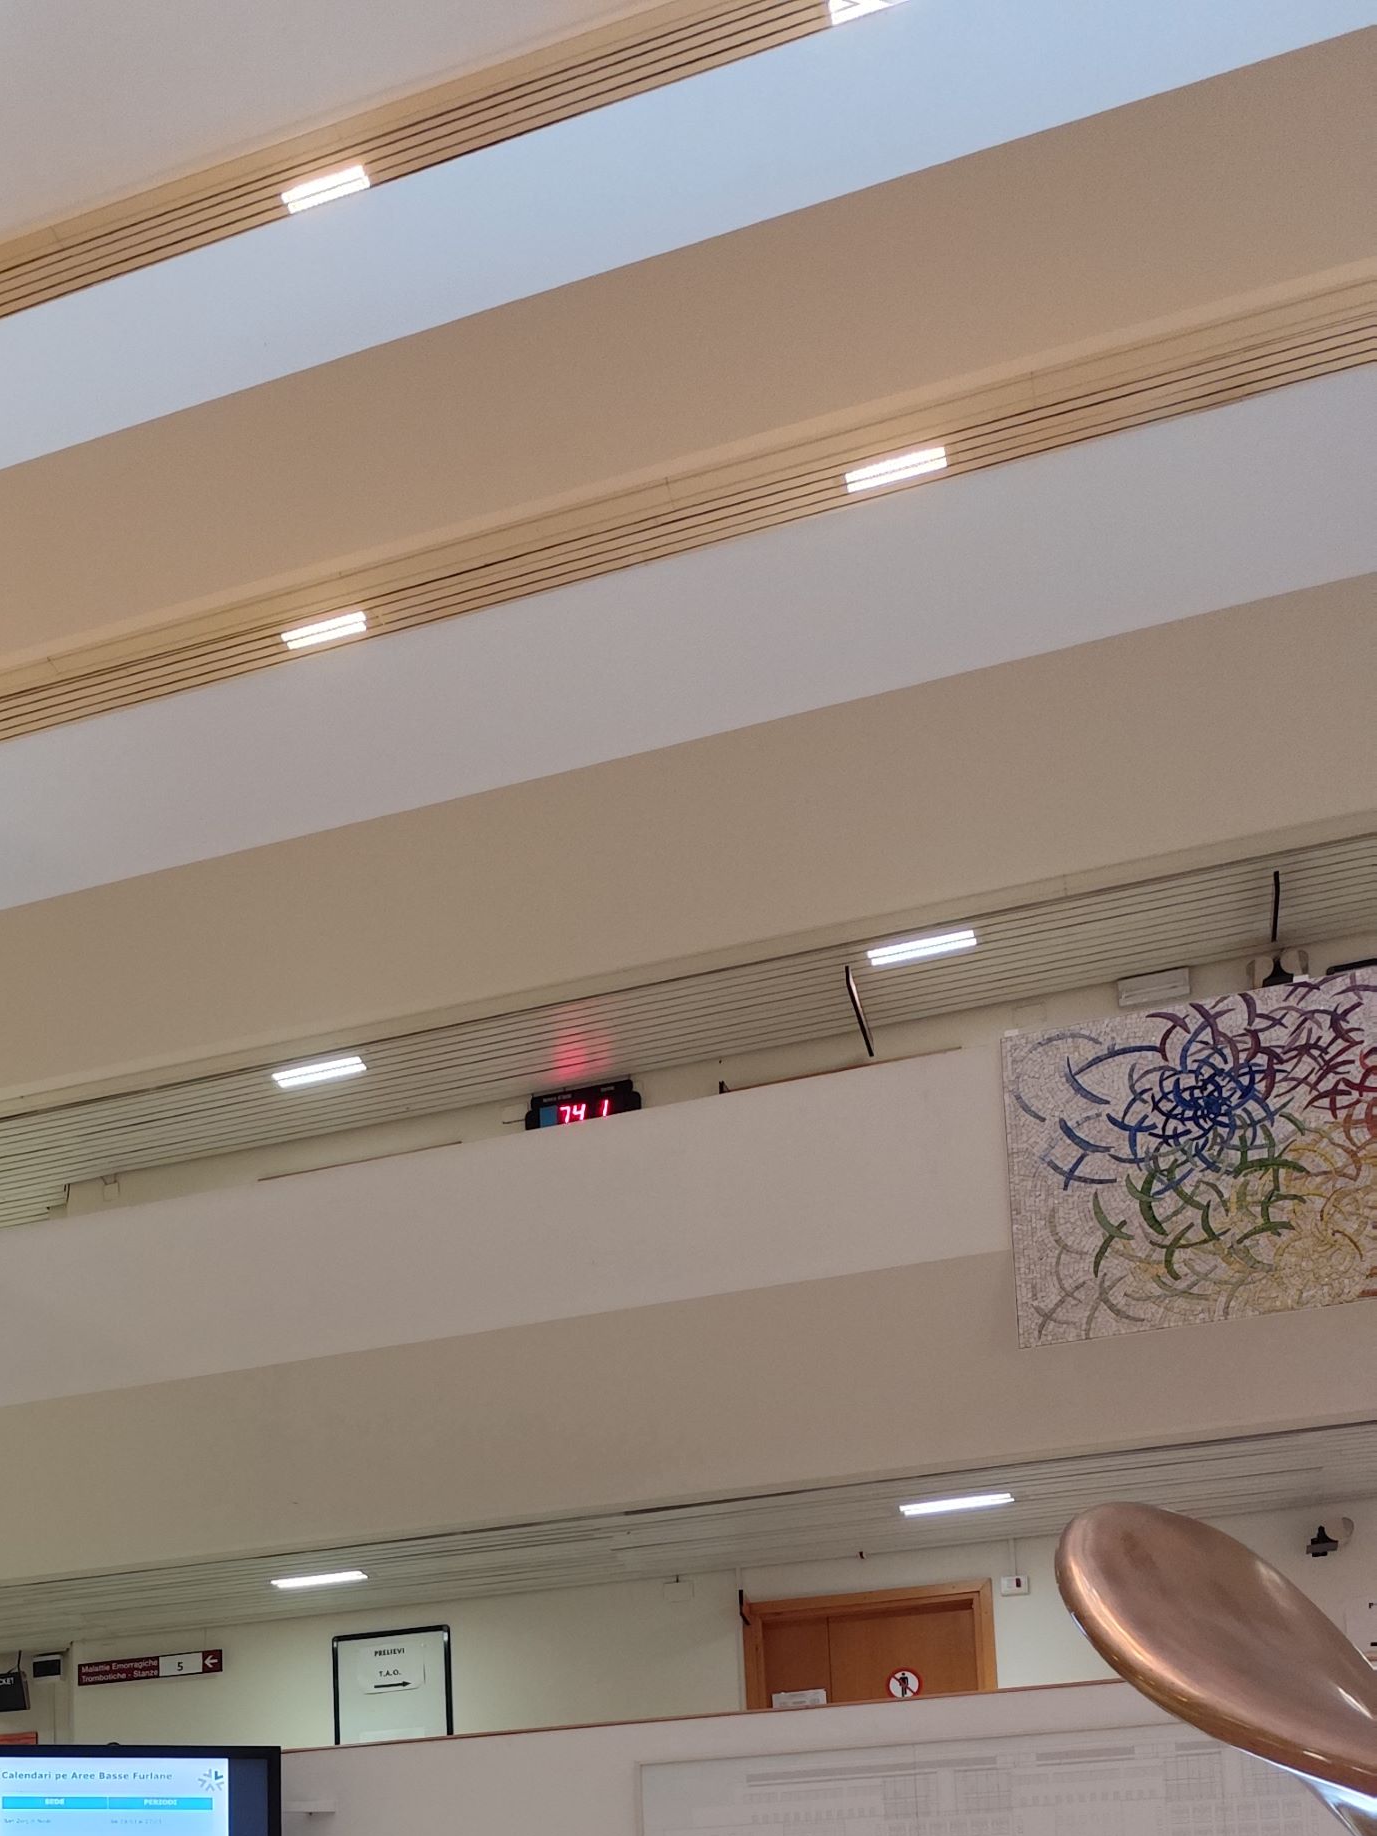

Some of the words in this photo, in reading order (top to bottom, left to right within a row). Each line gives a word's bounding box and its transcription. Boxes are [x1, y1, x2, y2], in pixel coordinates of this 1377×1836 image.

[560, 1103, 586, 1124] 74
[603, 1099, 609, 1117] 1
[374, 1648, 405, 1657] PRELIEVI
[111, 1659, 159, 1670] Emorragiche
[133, 1670, 159, 1678] Stanze
[177, 1661, 184, 1672] 5
[379, 1669, 402, 1677] T.A.O.
[2, 1771, 52, 1780] Calendari
[55, 1773, 68, 1781] pe
[71, 1772, 96, 1780] Aree
[99, 1772, 129, 1780] Basse
[133, 1772, 173, 1780] Furlane
